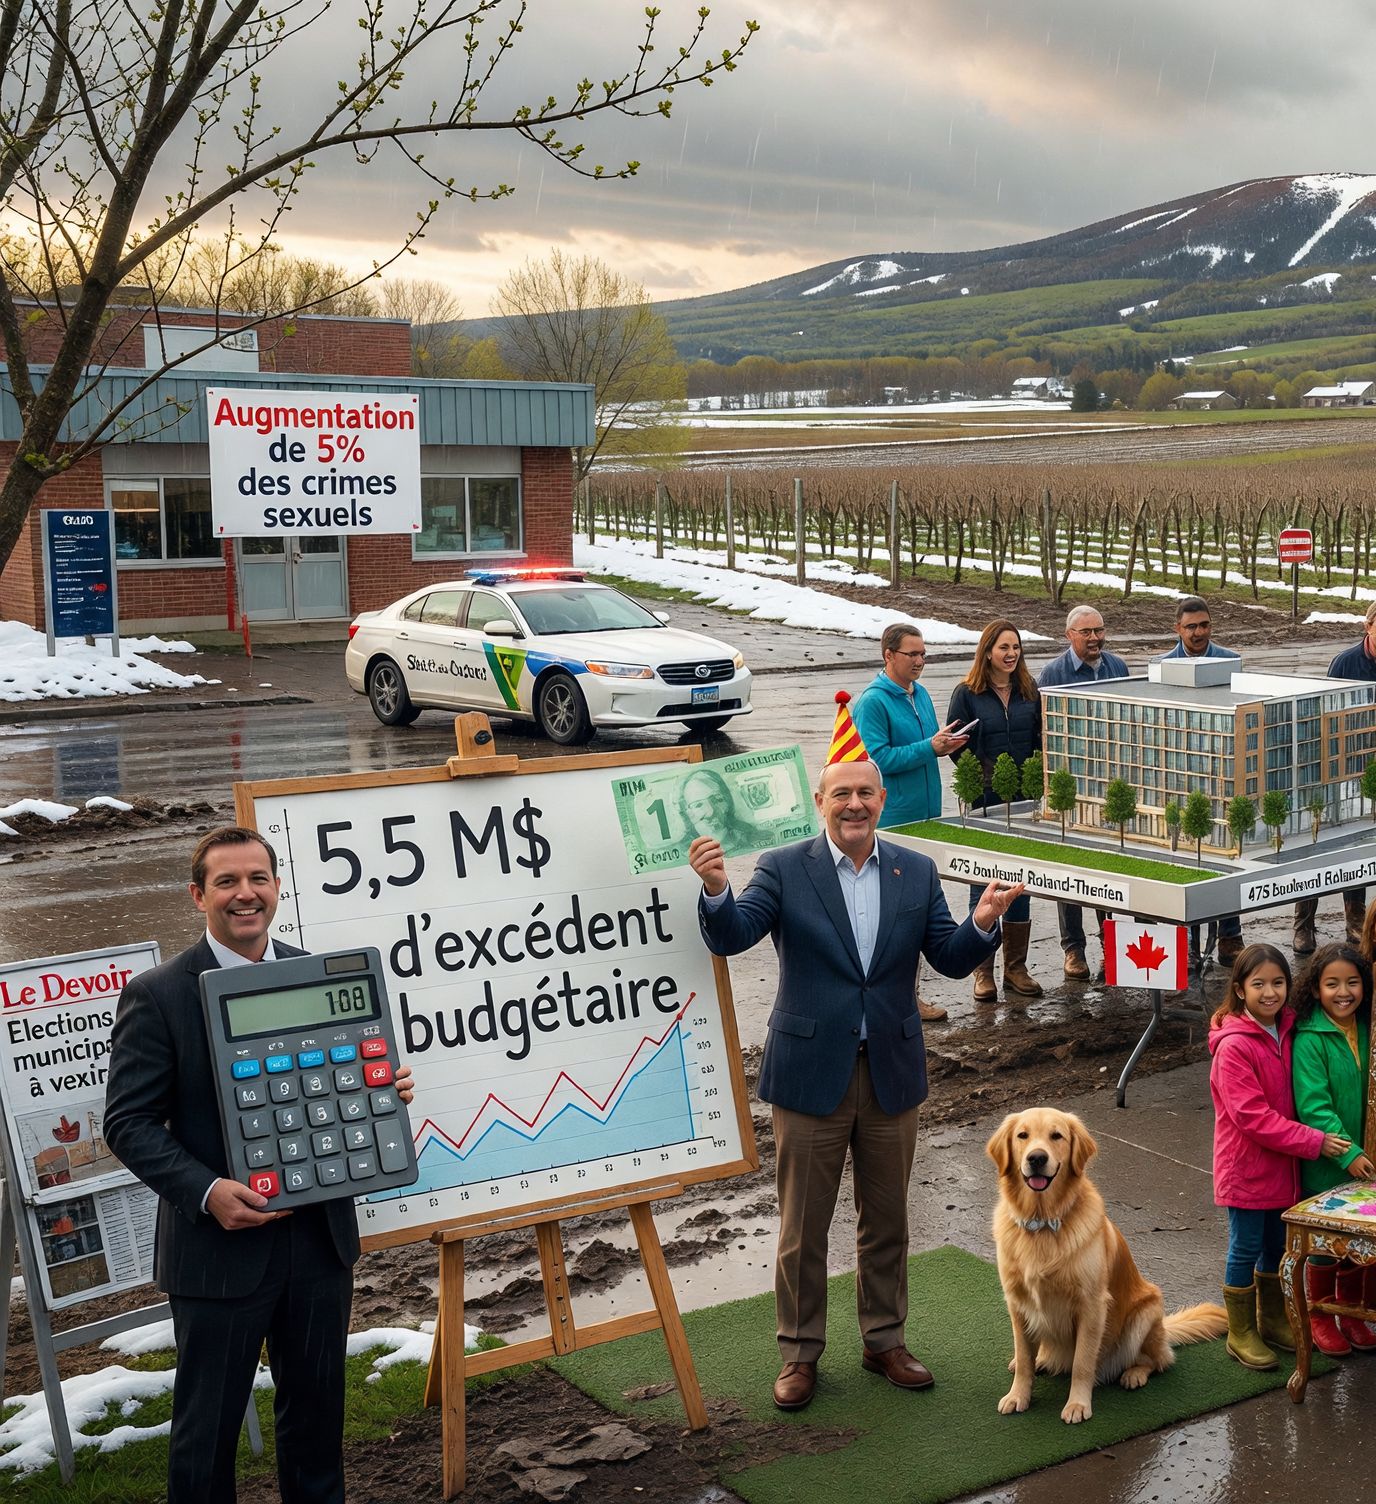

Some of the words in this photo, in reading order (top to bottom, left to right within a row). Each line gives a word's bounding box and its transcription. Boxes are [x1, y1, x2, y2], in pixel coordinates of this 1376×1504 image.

[214, 398, 414, 434] Augmentation
[269, 433, 306, 463] de
[317, 434, 365, 463] 5%
[238, 467, 291, 496] des
[302, 468, 397, 495] crimes
[264, 499, 373, 527] sexuels
[646, 798, 671, 841] 1
[317, 814, 425, 900] 5,5
[449, 797, 551, 879] M$
[949, 857, 971, 875] 475
[1248, 883, 1270, 902] 475
[389, 887, 674, 978] d'excédent
[0, 981, 37, 1008] Le
[39, 963, 133, 1003] Devoir
[7, 1010, 114, 1044] Elections
[399, 968, 682, 1061] budgétaire
